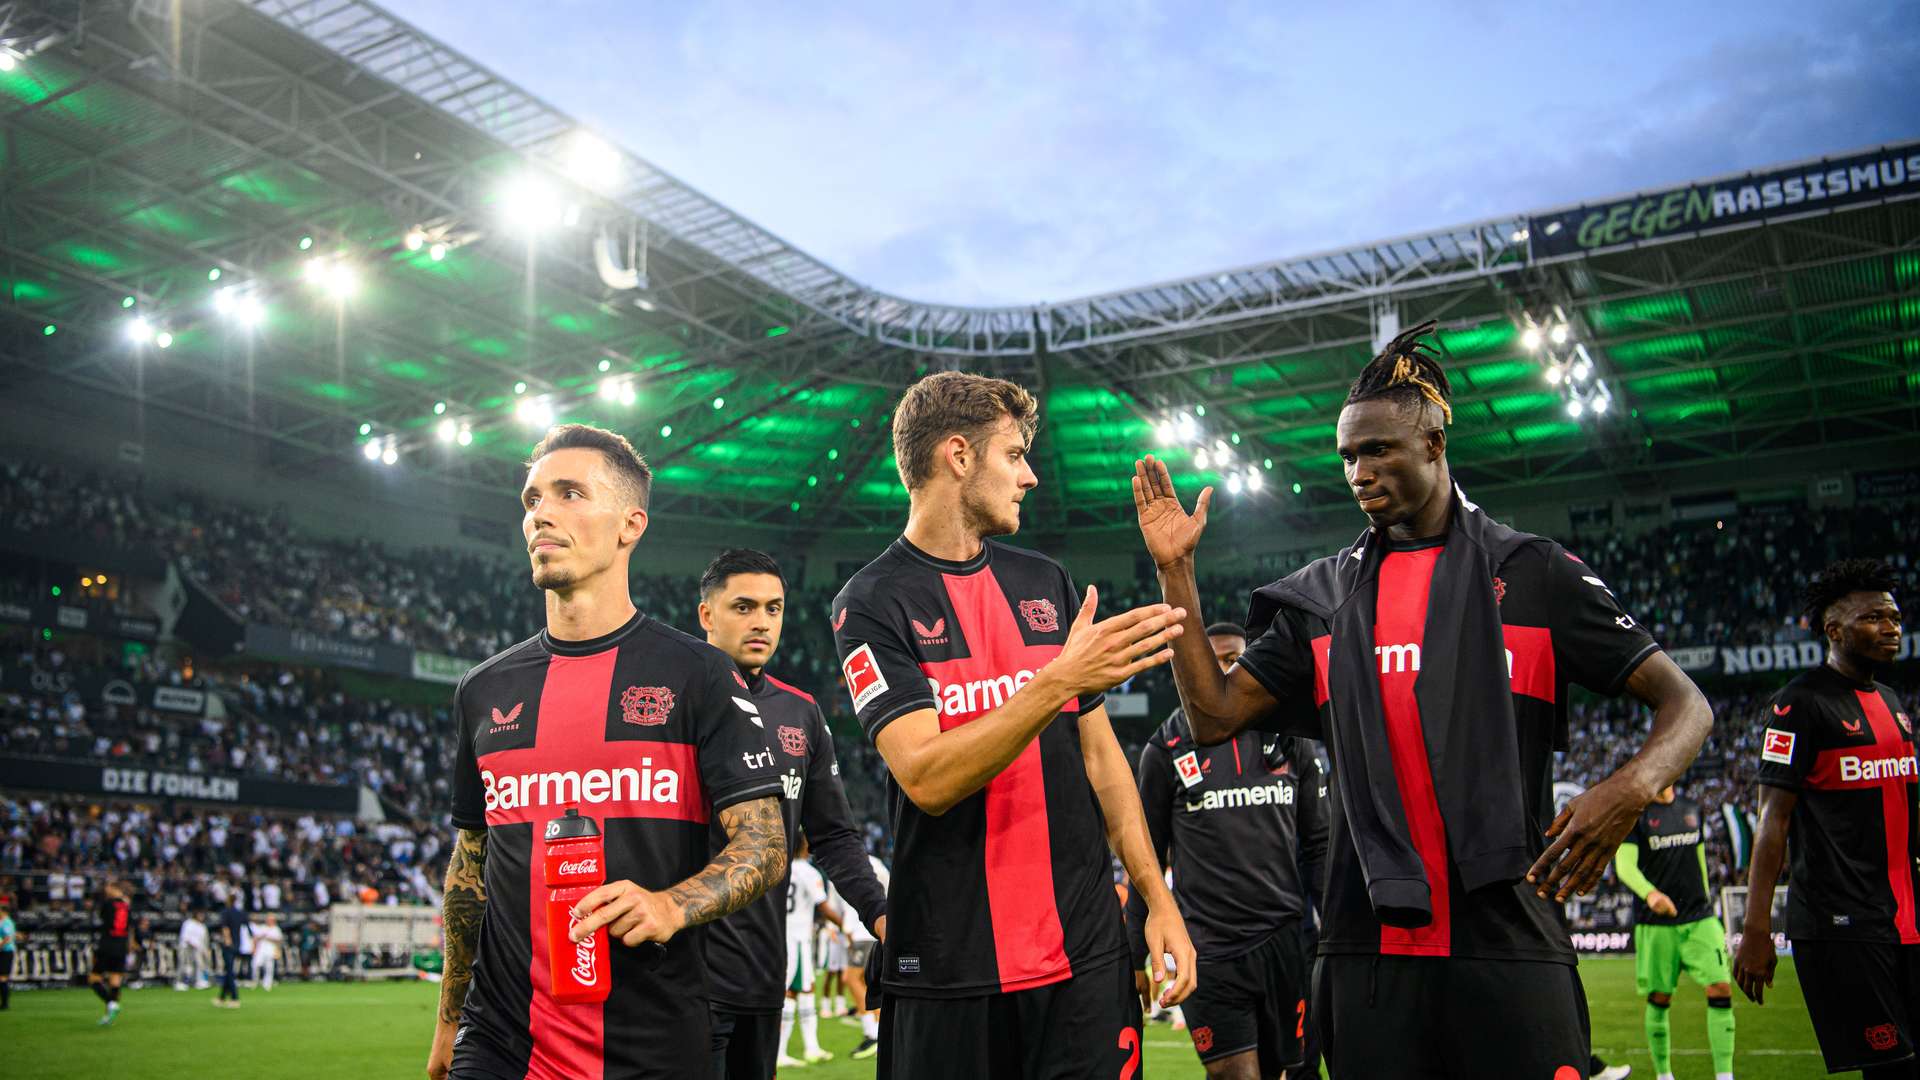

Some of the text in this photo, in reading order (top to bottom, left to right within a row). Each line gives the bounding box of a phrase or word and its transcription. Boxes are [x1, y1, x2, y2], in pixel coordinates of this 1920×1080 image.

[1577, 187, 1716, 248] GEGEN
[1720, 641, 1823, 675] NORD
[102, 768, 148, 793] DIE
[481, 757, 679, 811] Barmenia
